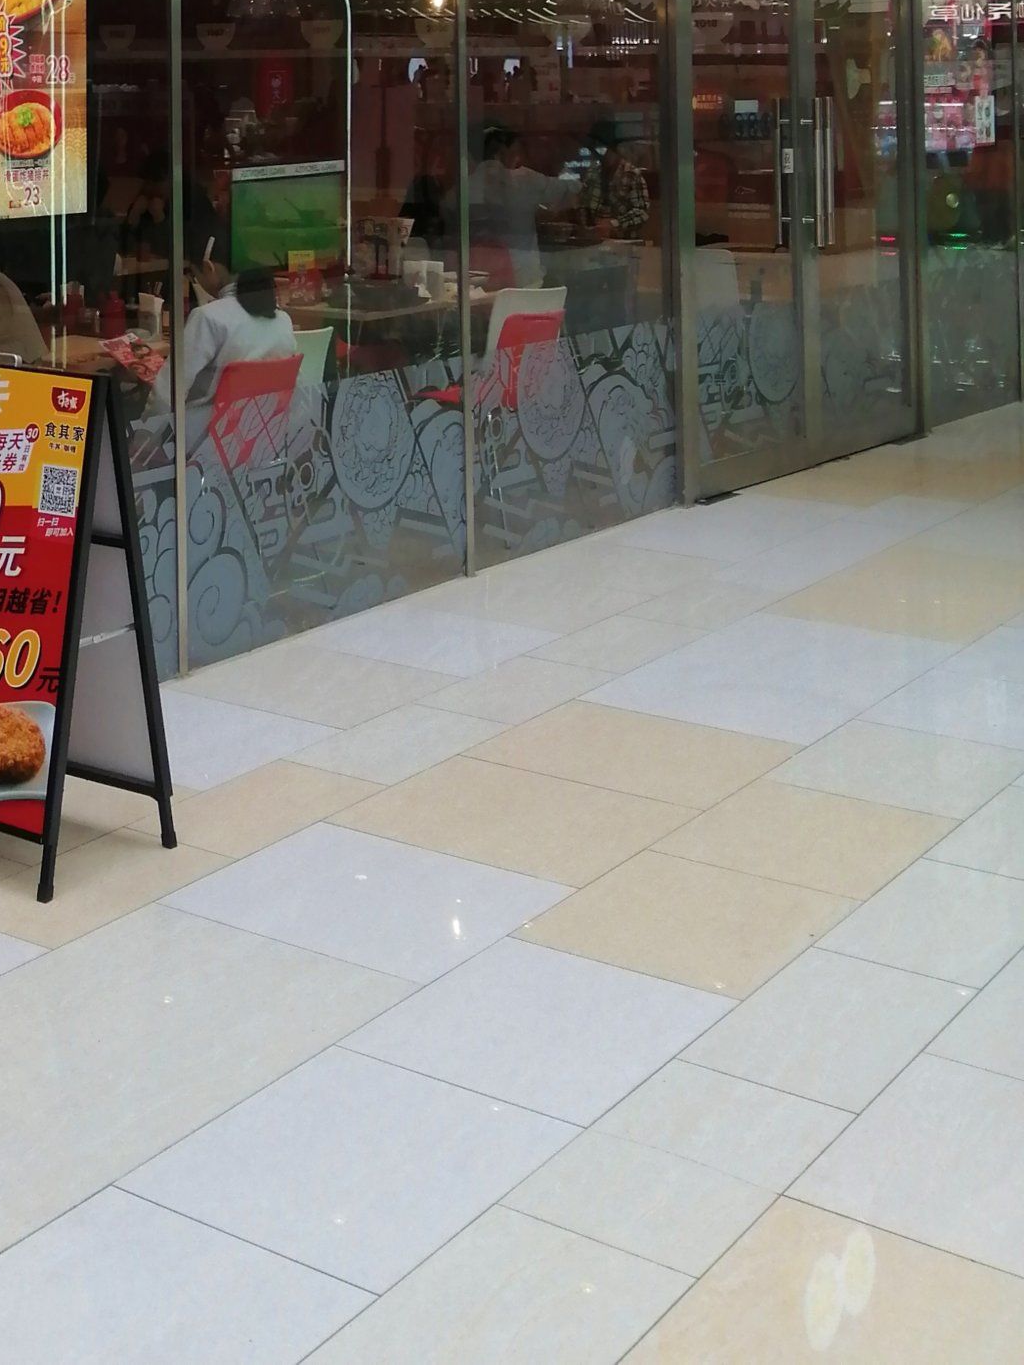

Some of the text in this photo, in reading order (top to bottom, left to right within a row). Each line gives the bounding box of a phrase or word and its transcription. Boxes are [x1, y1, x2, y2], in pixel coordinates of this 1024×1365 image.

[26, 427, 39, 440] 30
[44, 422, 85, 442] 食其家
[37, 517, 59, 528] 扫一扫
